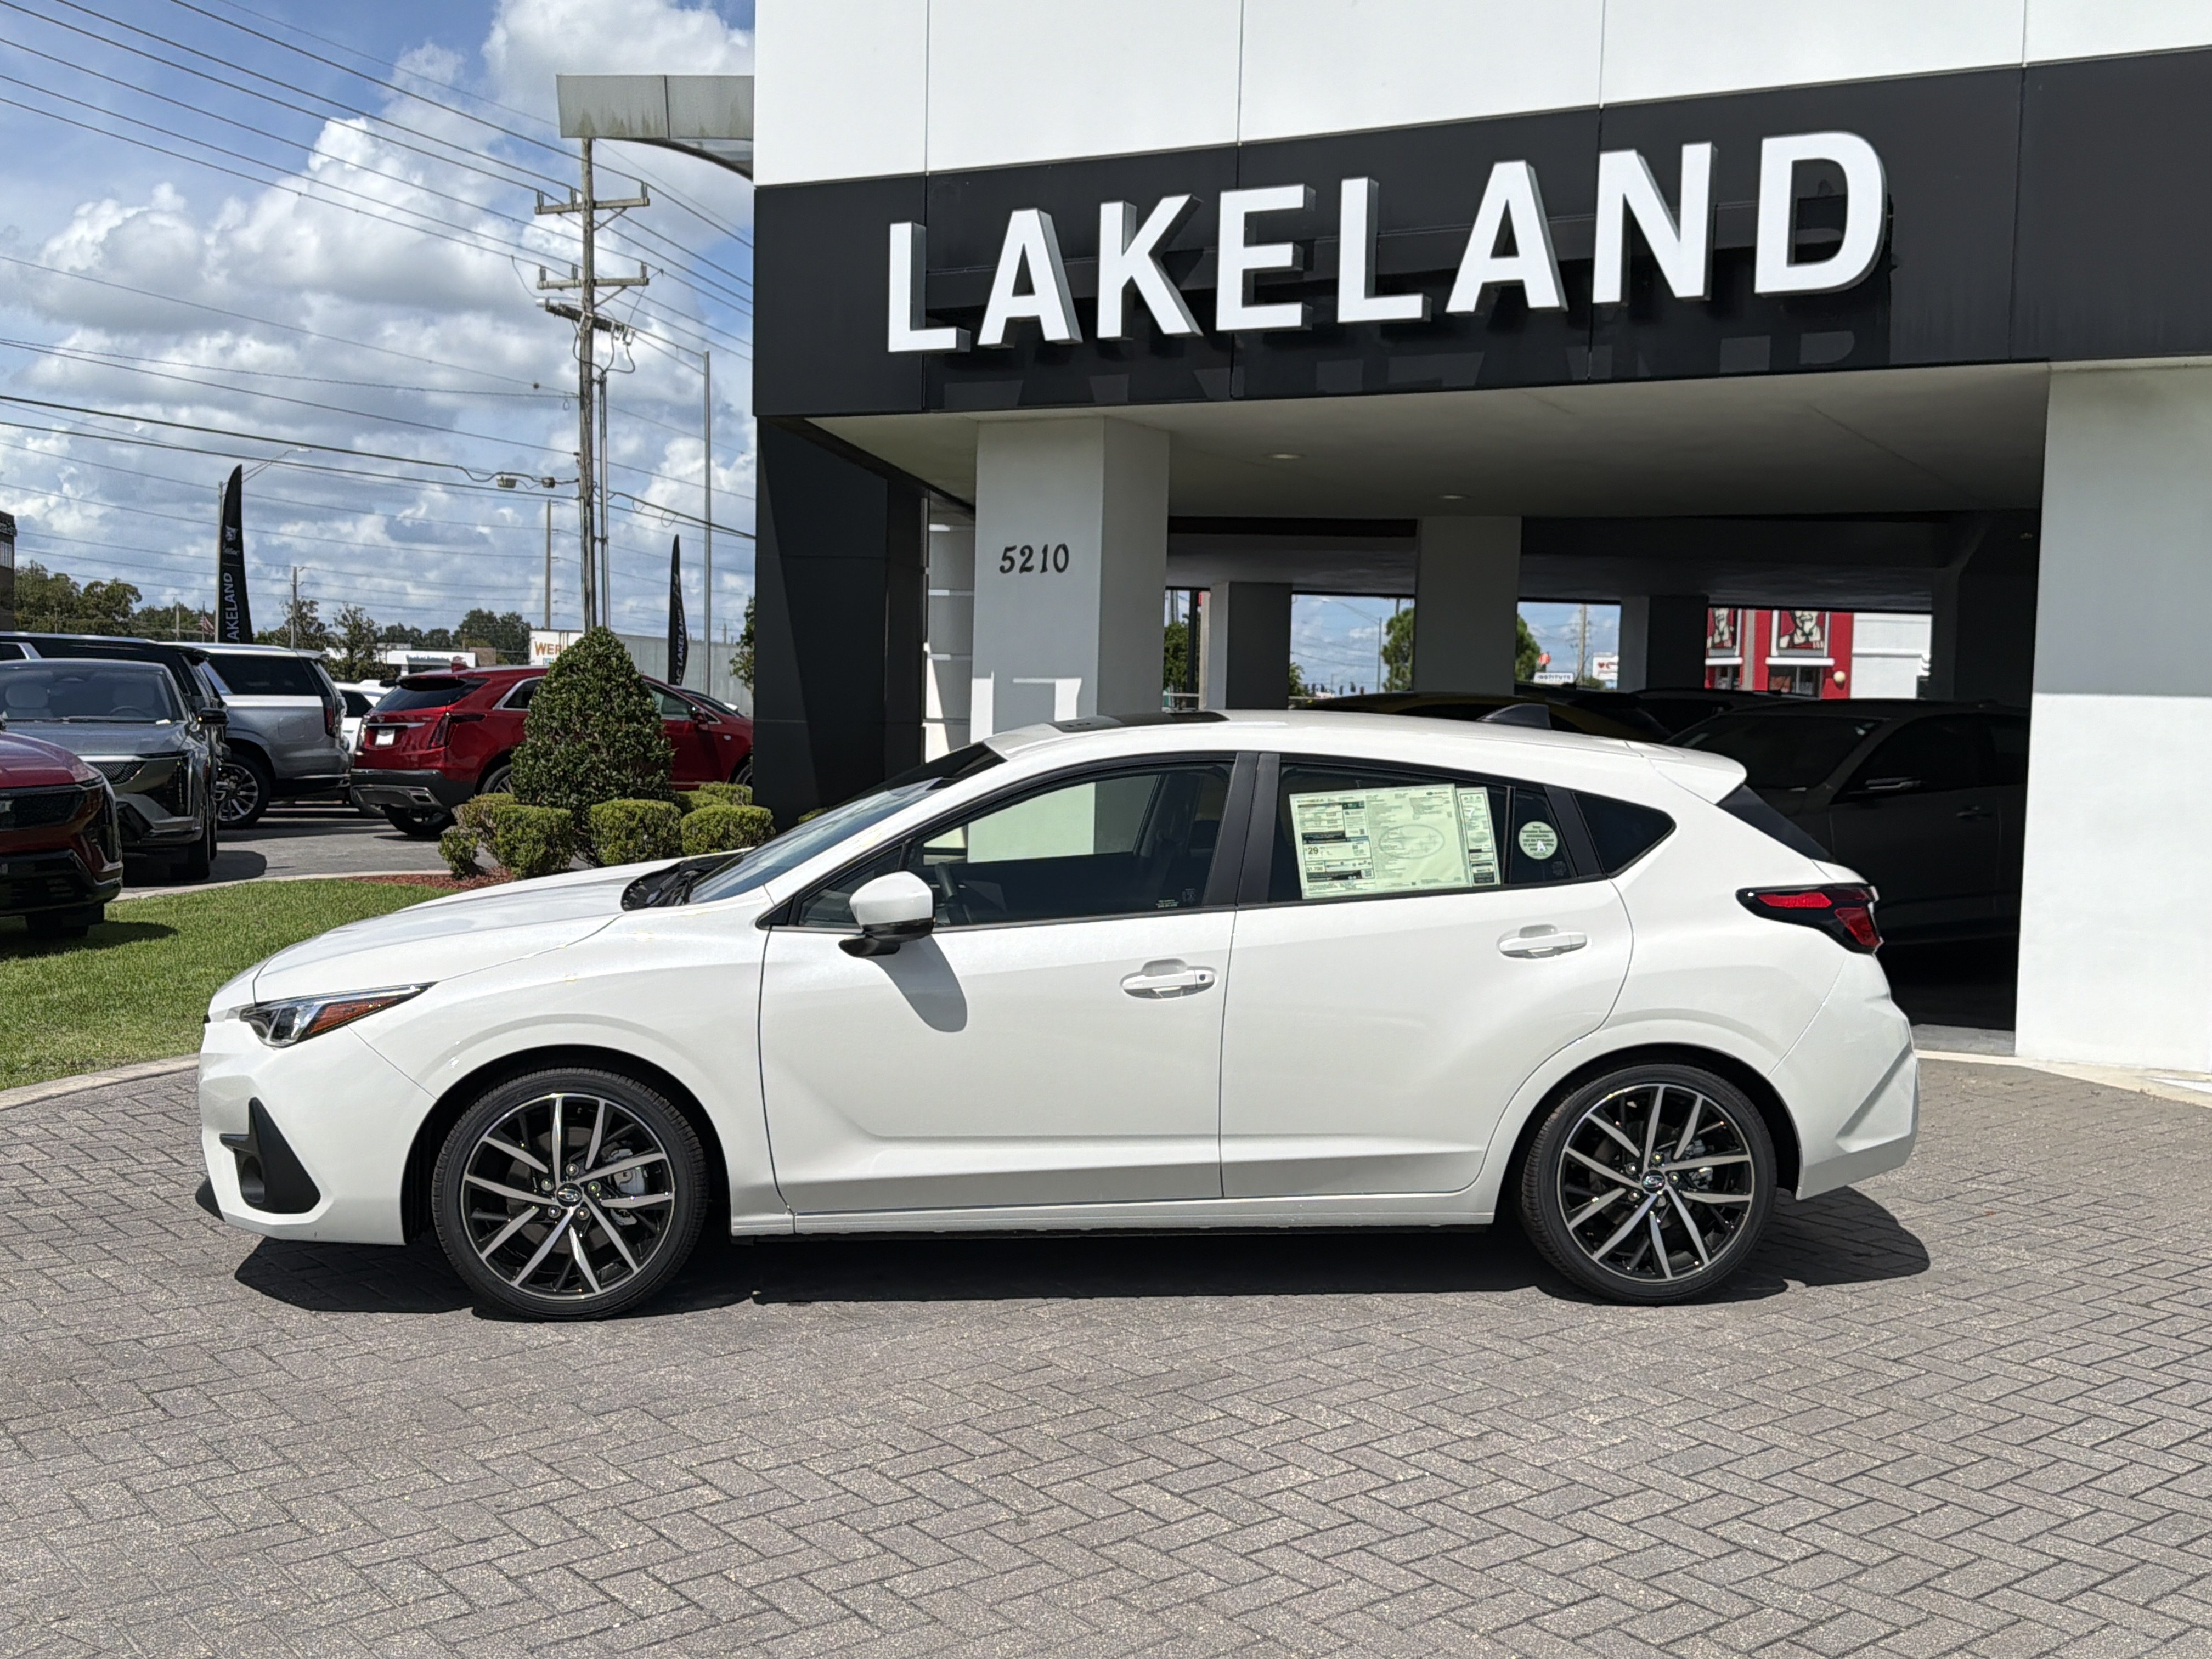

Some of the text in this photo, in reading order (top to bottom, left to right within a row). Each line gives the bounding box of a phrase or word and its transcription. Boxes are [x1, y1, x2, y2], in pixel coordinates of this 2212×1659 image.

[888, 129, 1887, 353] LAKELAND
[1000, 543, 1069, 574] 5210
[223, 572, 240, 641] AKELAND
[1307, 847, 1319, 855] 29
